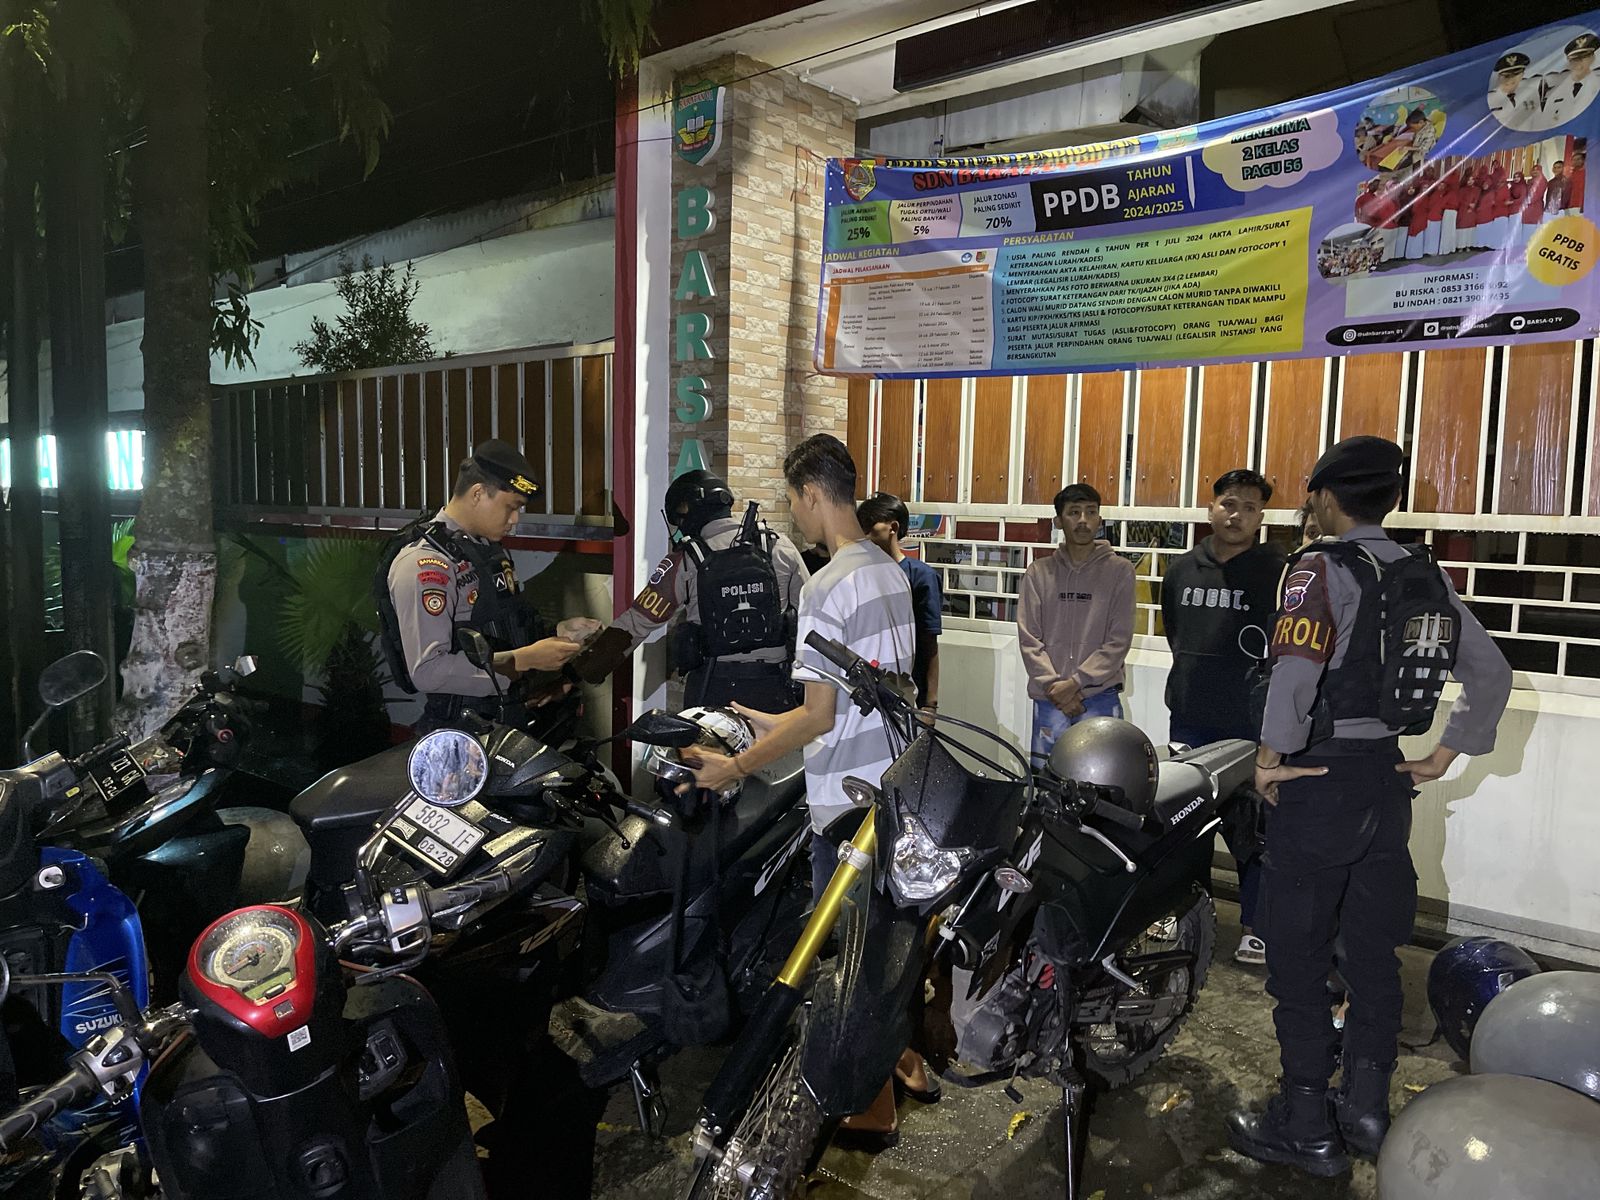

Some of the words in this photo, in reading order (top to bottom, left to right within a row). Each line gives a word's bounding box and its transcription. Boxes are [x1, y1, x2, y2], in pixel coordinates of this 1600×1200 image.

[1231, 117, 1311, 144] MENERIMA
[1242, 146, 1253, 161] 2
[1255, 138, 1299, 159] KELAS
[1127, 165, 1172, 182] TAHUN
[1242, 162, 1281, 180] PAGU
[1283, 157, 1303, 174] 56
[912, 169, 954, 191] SDN
[974, 194, 993, 205] JALUR
[993, 191, 1018, 202] ZONASI
[1043, 183, 1120, 218] PPDB
[1128, 183, 1175, 202] AJARAN
[916, 199, 953, 207] PERPINDAHAN
[973, 205, 996, 214] PALING
[997, 201, 1021, 211] SEDIKIT
[1123, 200, 1185, 219] 2024/2025
[913, 225, 930, 236] 5%
[985, 216, 1012, 229] 70%
[847, 226, 871, 241] 25%
[1003, 231, 1074, 246] PERSYARATAN
[1032, 251, 1056, 259] PALING
[1061, 248, 1090, 257] RENDAH
[1105, 244, 1131, 252] TAHUN
[1136, 241, 1150, 249] PER
[1164, 238, 1180, 247] JULI
[1186, 234, 1204, 243] 2024
[1209, 230, 1232, 240] (AKTA
[1238, 220, 1291, 235] LAHIR/SURAT
[1552, 234, 1585, 253] PPDB
[824, 251, 856, 263] JADWAL
[858, 248, 900, 259] KEGIATAN
[1008, 268, 1059, 278] MENYERAHKAN
[1078, 263, 1119, 272] KELAHIRAN,
[1120, 261, 1144, 269] KARTU
[1145, 256, 1184, 266] KELUARGA
[1184, 253, 1200, 262] (KK)
[1201, 251, 1218, 259] ASLI
[1219, 248, 1237, 256] DAN
[1238, 241, 1280, 254] FOTOCOPY
[1009, 261, 1055, 269] KETERANGAN
[1054, 255, 1104, 266] LURAH/KADES)
[1538, 247, 1580, 271] GRATIS
[832, 267, 854, 275] JADWAL
[854, 264, 891, 273] PELAKSANAAN
[1423, 272, 1474, 284] INFORMASI
[1006, 279, 1033, 287] LEMBAR
[1034, 275, 1070, 286] (LEGALISIR
[1070, 272, 1120, 282] LURAH/KADES)
[1006, 286, 1055, 296] MENYERAHKAN
[1070, 283, 1089, 291] FOTO
[1090, 280, 1129, 290] BERWARNA
[1130, 276, 1161, 286] UKURAN
[1177, 274, 1184, 282] (2
[1185, 269, 1218, 279] LEMBAR)
[1006, 296, 1039, 306] FOTOCOPY
[1039, 294, 1061, 302] SURAT
[1062, 290, 1108, 301] KETERANGAN
[1109, 289, 1127, 297] DARI
[1127, 286, 1163, 296] TK/IJAZAH
[1163, 284, 1181, 292] (JIKA
[1182, 281, 1201, 289] ADA)
[1006, 306, 1027, 315] CALON
[1028, 304, 1044, 312] WALI
[1045, 303, 1068, 311] MURID
[1068, 301, 1097, 310] DATANG
[1098, 298, 1126, 308] SENDIRI
[1126, 295, 1157, 305] DENGAN
[1158, 293, 1185, 301] CALON
[1185, 290, 1212, 299] MURID
[1214, 287, 1241, 296] TANPA
[1242, 284, 1281, 295] DIWAKILI
[1395, 289, 1408, 298] BU
[1409, 286, 1435, 297] RISKA
[1441, 284, 1462, 293] 0853
[1463, 282, 1485, 291] 3166
[1082, 309, 1100, 318] (ASLI
[1107, 304, 1171, 315] FOTOCOPY/SURAT
[1173, 300, 1225, 310] KETERANGAN
[1227, 297, 1250, 305] TIDAK
[1253, 294, 1286, 304] MAMPU
[1392, 300, 1406, 309] BU
[1407, 297, 1436, 308] INDAH
[1442, 296, 1462, 304] 0821
[1465, 294, 1484, 302] 390
[1007, 325, 1022, 333] BAGI
[1022, 324, 1048, 332] PESERTA
[1048, 322, 1069, 331] JALUR
[1069, 320, 1101, 329] AFIRMASI
[1031, 331, 1078, 341] MUTASI/SURAT
[1084, 329, 1106, 337] TUGAS
[1111, 323, 1176, 336] (ASLI&FOTOCOPY)
[1182, 321, 1211, 330] ORANG
[1218, 317, 1257, 327] TUA/WALI
[1264, 314, 1284, 323] BAGI
[1034, 342, 1054, 351] JALUR
[1056, 339, 1105, 349] PERPINDAHAN
[1107, 337, 1133, 345] ORANG
[1137, 333, 1173, 344] TUA/WALI
[1175, 331, 1217, 342] (LEGALISIR
[1220, 327, 1256, 337] INSTANSI
[1260, 325, 1283, 334] YANG
[1006, 352, 1057, 361] BERSANGKUTAN
[721, 582, 764, 597] POLISI
[415, 805, 450, 835] 5832
[1170, 796, 1205, 826] HONDA
[75, 1013, 123, 1034] SUZUKI
